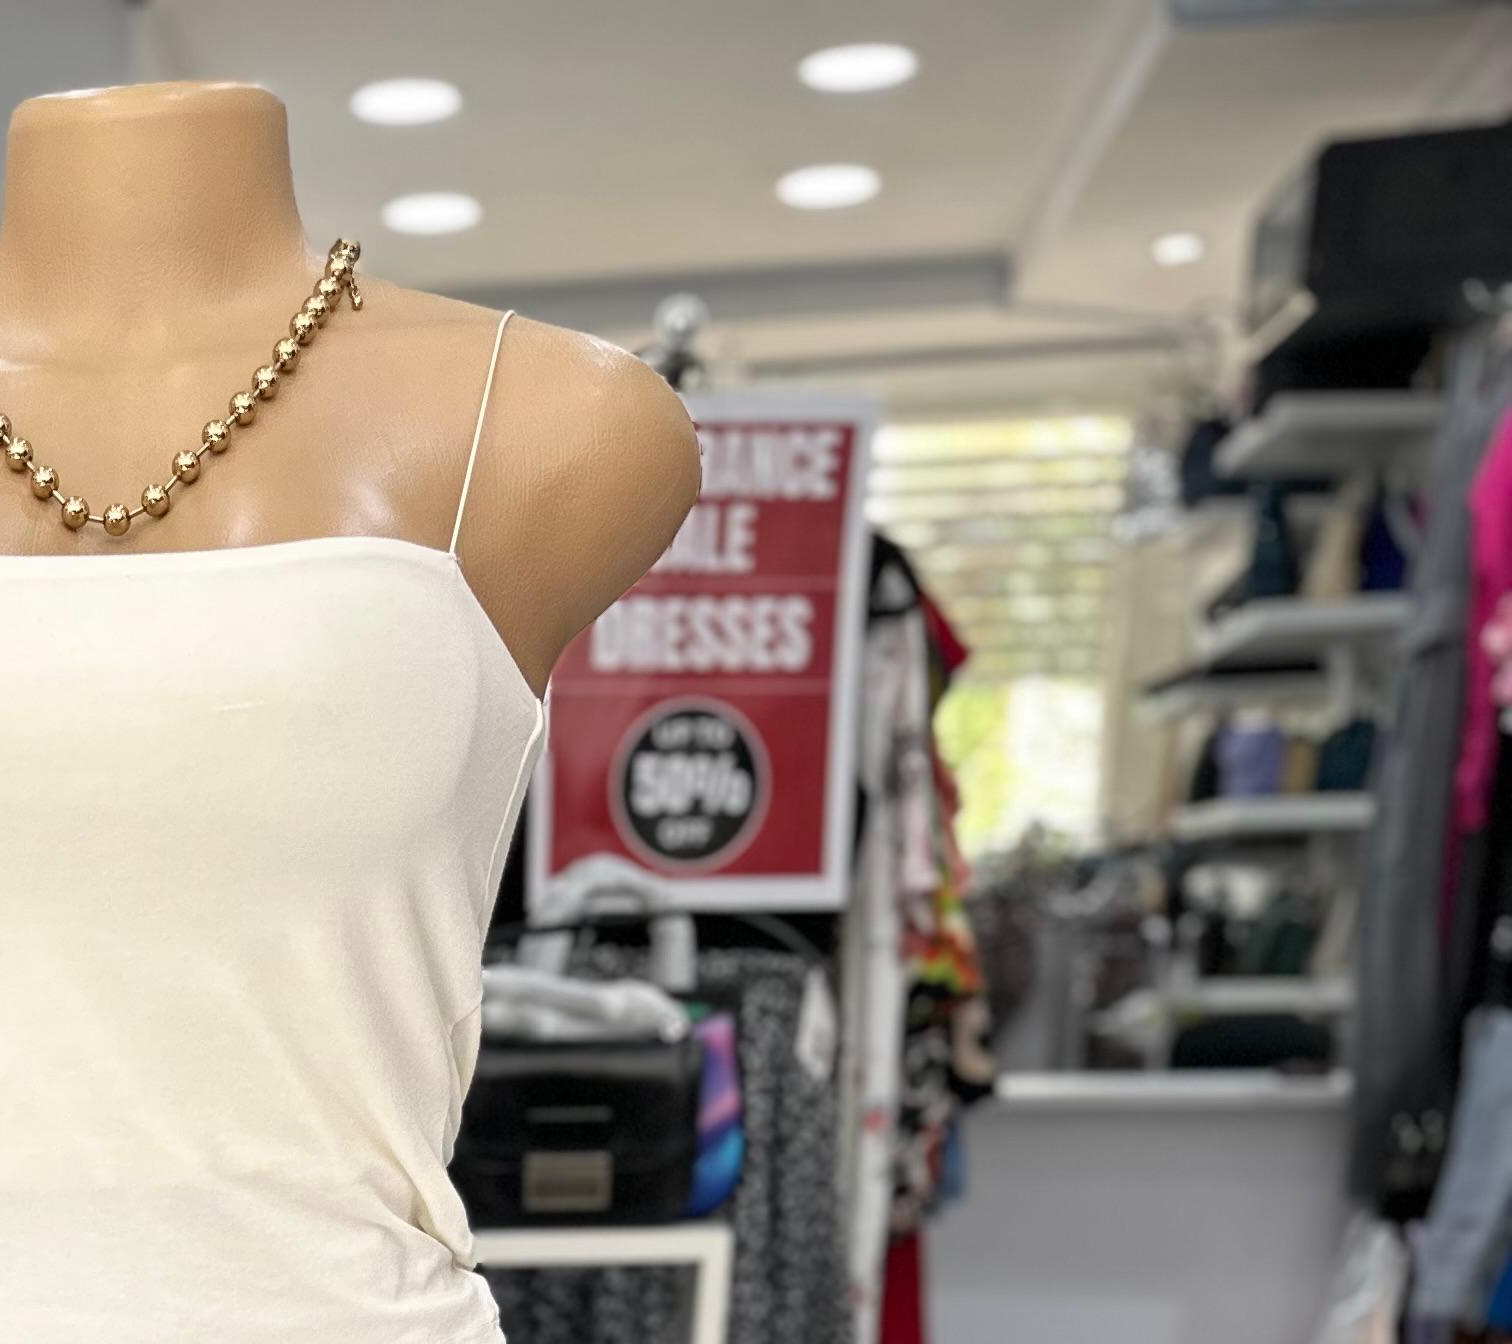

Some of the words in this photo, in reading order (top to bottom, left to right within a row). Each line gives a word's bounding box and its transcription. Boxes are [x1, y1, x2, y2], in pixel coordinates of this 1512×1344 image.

[652, 502, 757, 575] ALE
[591, 595, 814, 673] DRESSES
[630, 751, 753, 818] 50%
